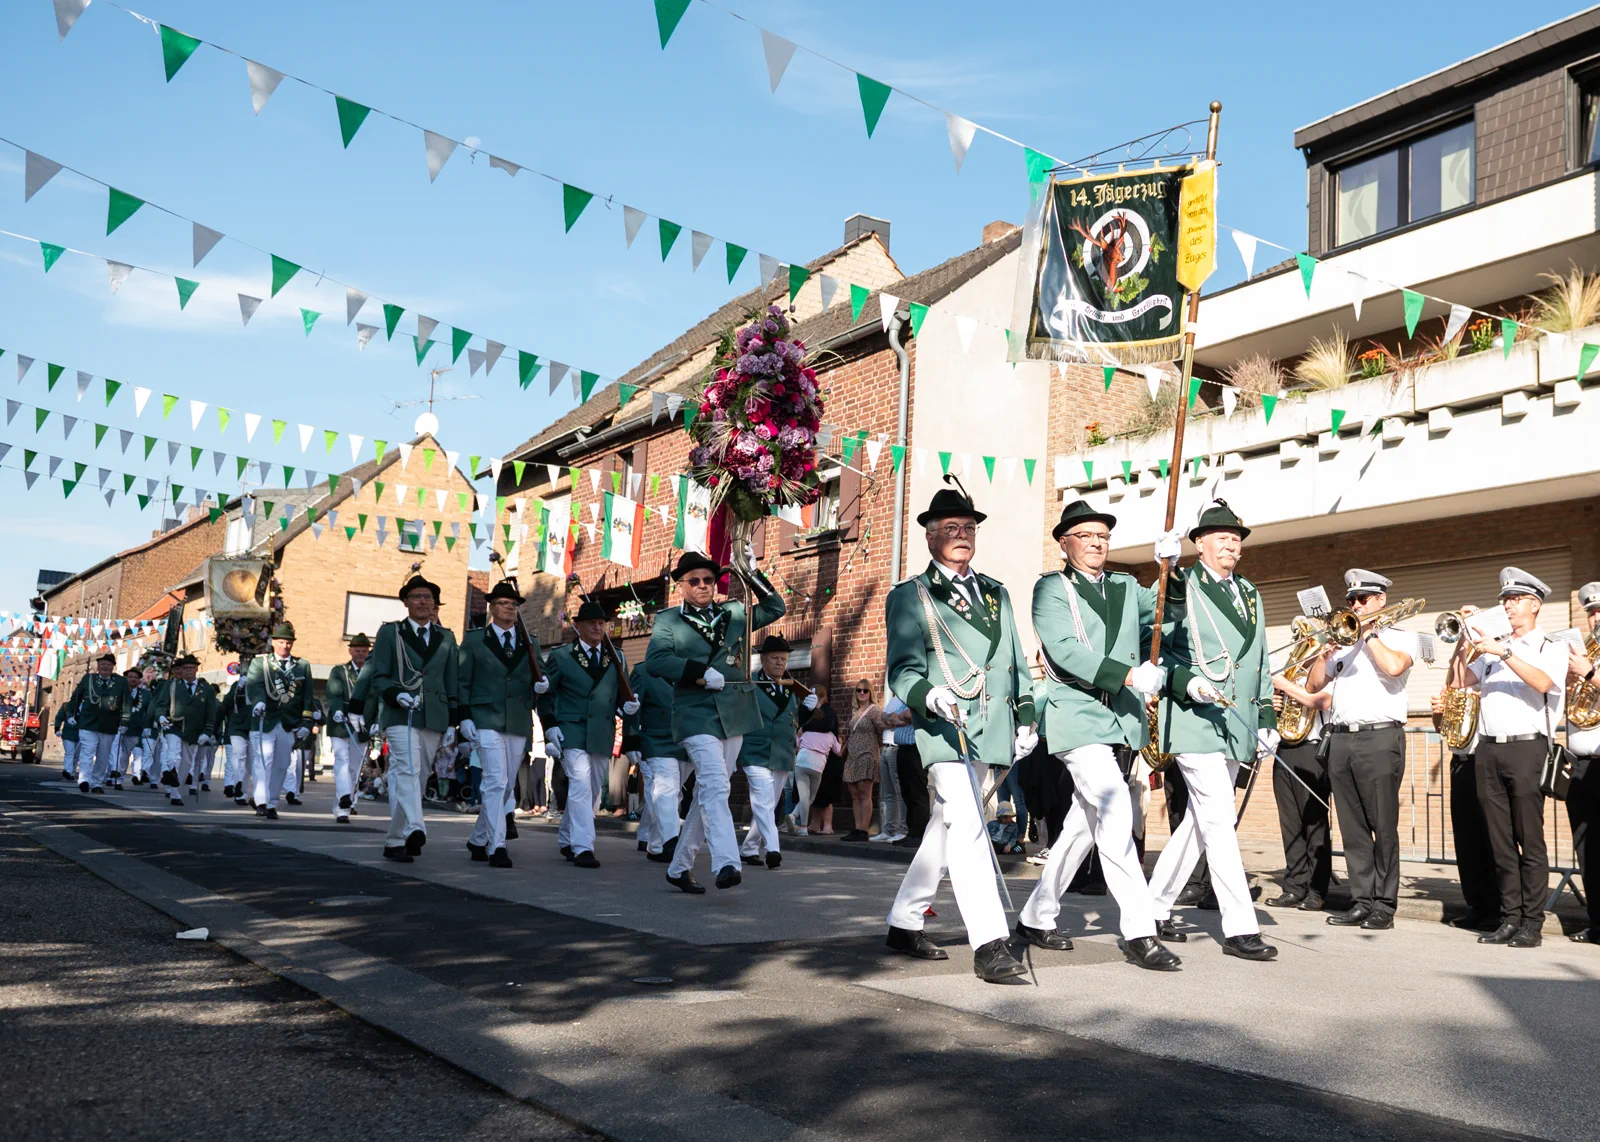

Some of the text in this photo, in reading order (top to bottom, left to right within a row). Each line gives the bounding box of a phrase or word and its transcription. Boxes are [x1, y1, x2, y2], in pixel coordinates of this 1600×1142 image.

[1070, 181, 1167, 208] 14. Jägerzug
[1189, 236, 1203, 246] des
[1185, 252, 1207, 264] Zuges
[1112, 313, 1124, 321] und
